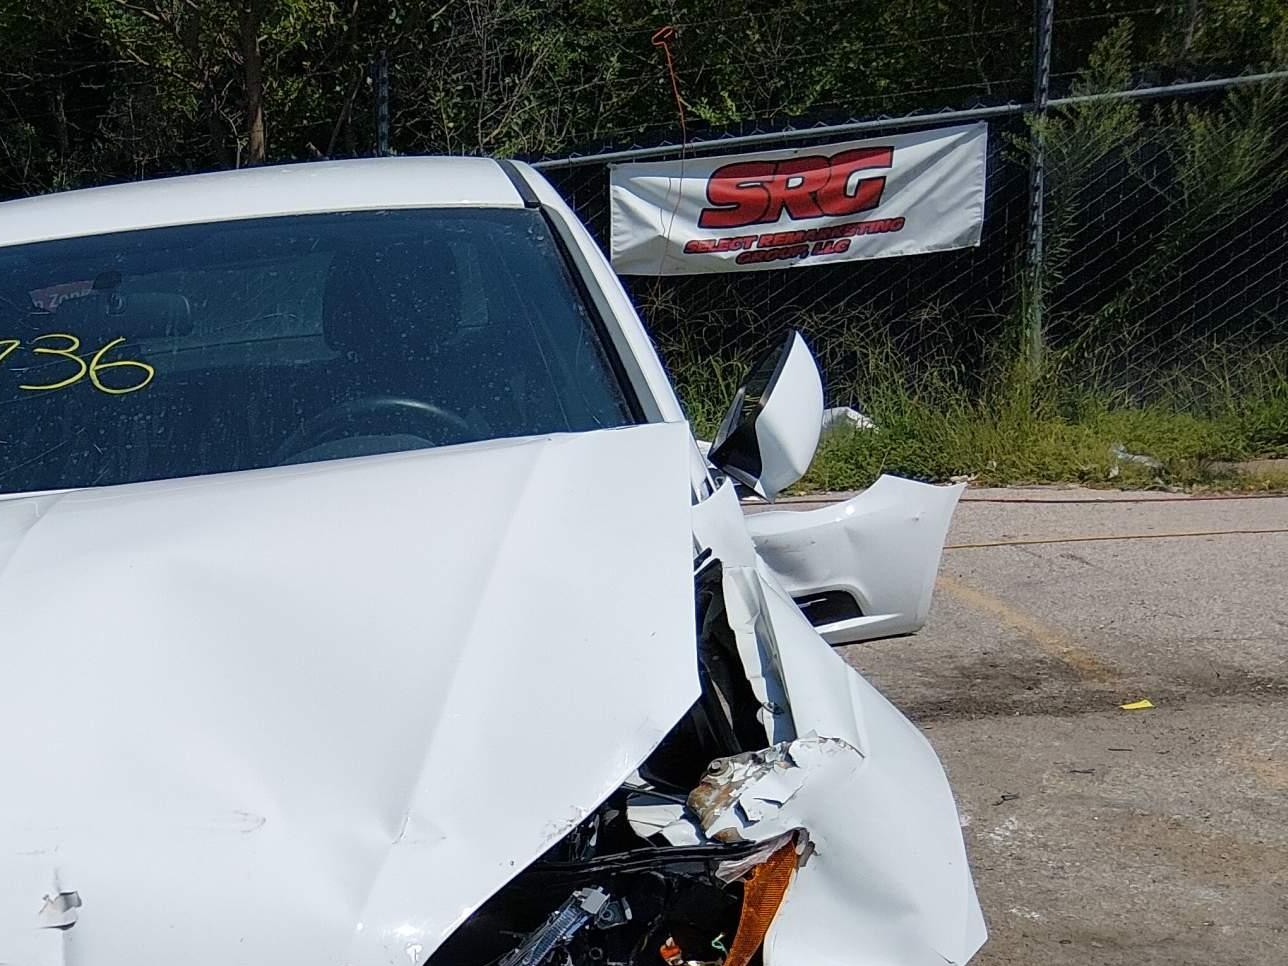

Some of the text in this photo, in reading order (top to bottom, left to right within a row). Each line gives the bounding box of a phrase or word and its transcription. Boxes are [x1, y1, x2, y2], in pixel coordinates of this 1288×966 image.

[698, 146, 894, 229] SRG
[683, 217, 905, 254] SELECT REMARKETING
[811, 239, 852, 256] LLC
